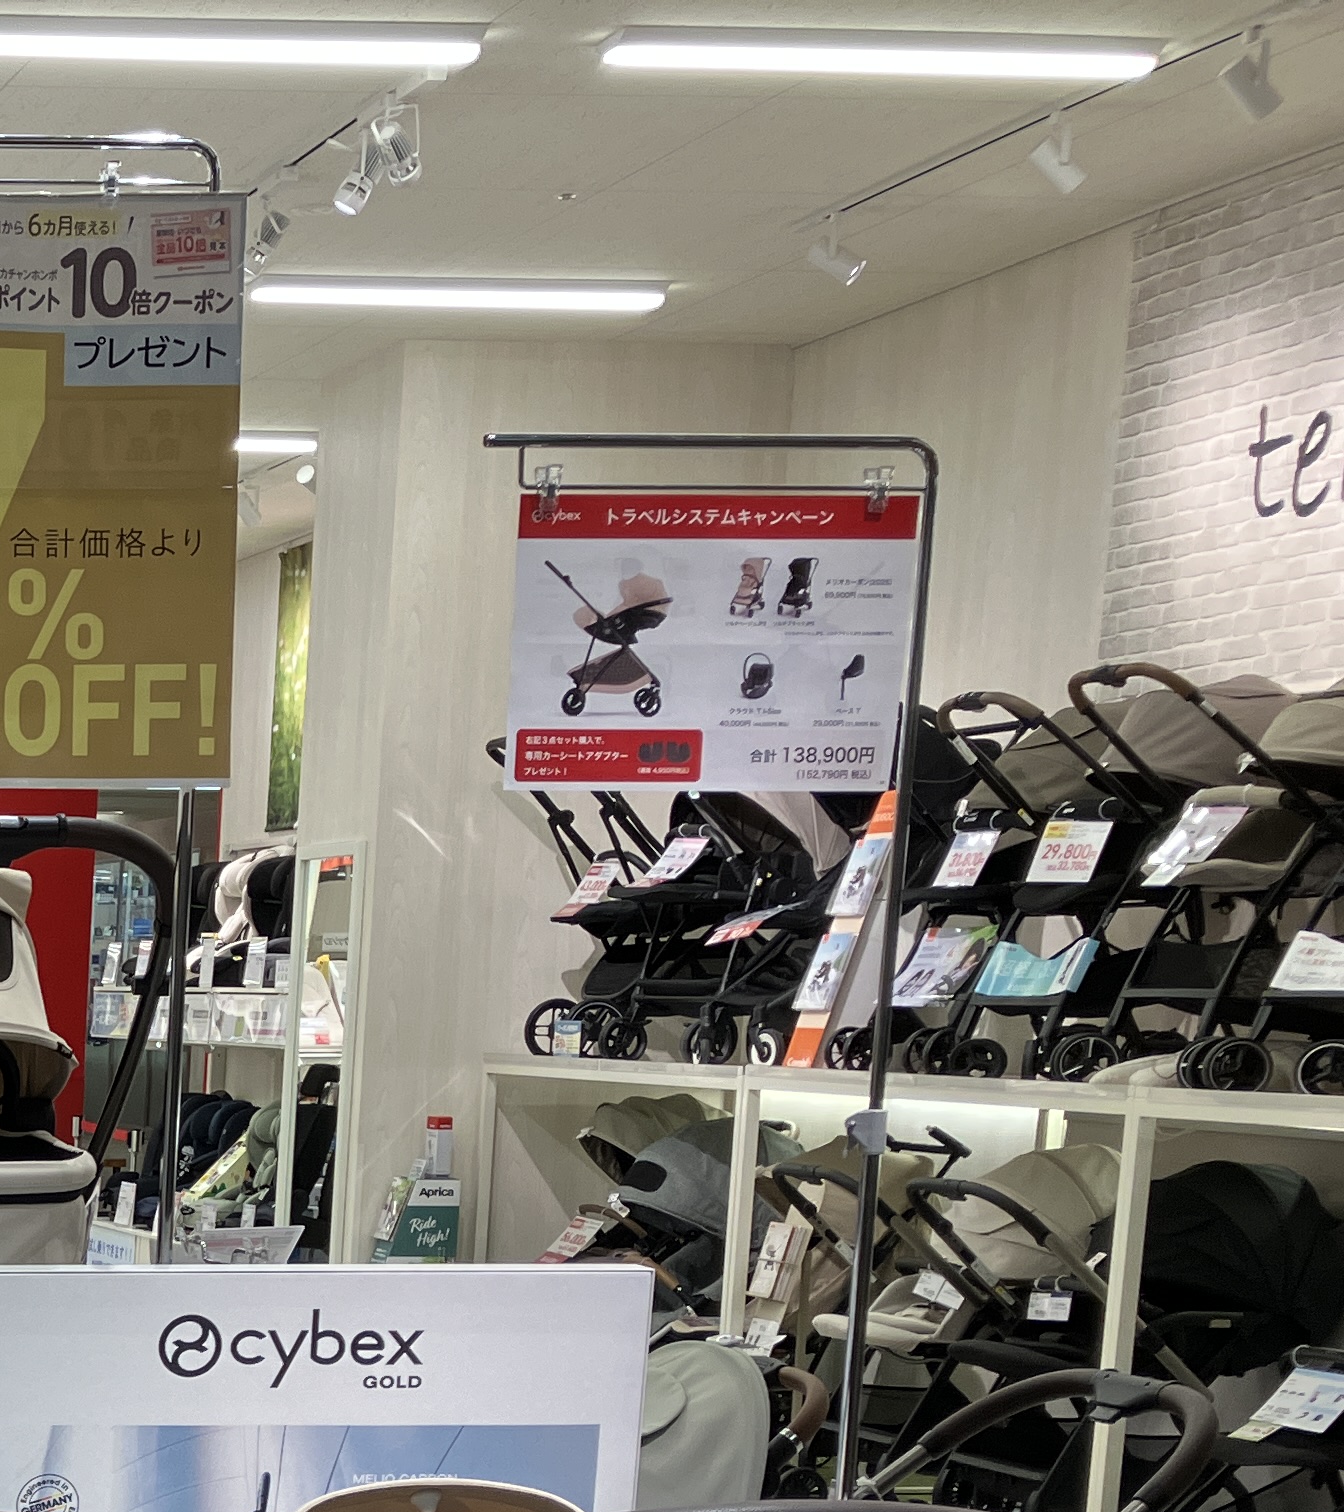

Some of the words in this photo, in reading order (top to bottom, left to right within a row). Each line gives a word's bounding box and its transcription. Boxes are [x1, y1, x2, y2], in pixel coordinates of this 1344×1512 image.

[60, 247, 136, 318] 10
[131, 289, 234, 316] 倍クーポン
[73, 336, 227, 369] プレゼント
[1250, 405, 1344, 517] te
[606, 508, 834, 526] トラベルシステムキャンペーン
[8, 529, 203, 560] 合計価格より
[5, 664, 218, 759] OFF!
[750, 749, 777, 763] 合計
[783, 746, 875, 764] 138,900円
[1041, 844, 1096, 860] 29,800円
[419, 1186, 455, 1200] Aprica
[409, 1217, 438, 1233] Ride
[417, 1228, 449, 1247] High!
[231, 1309, 425, 1388] cybex
[363, 1375, 422, 1389] GOLD
